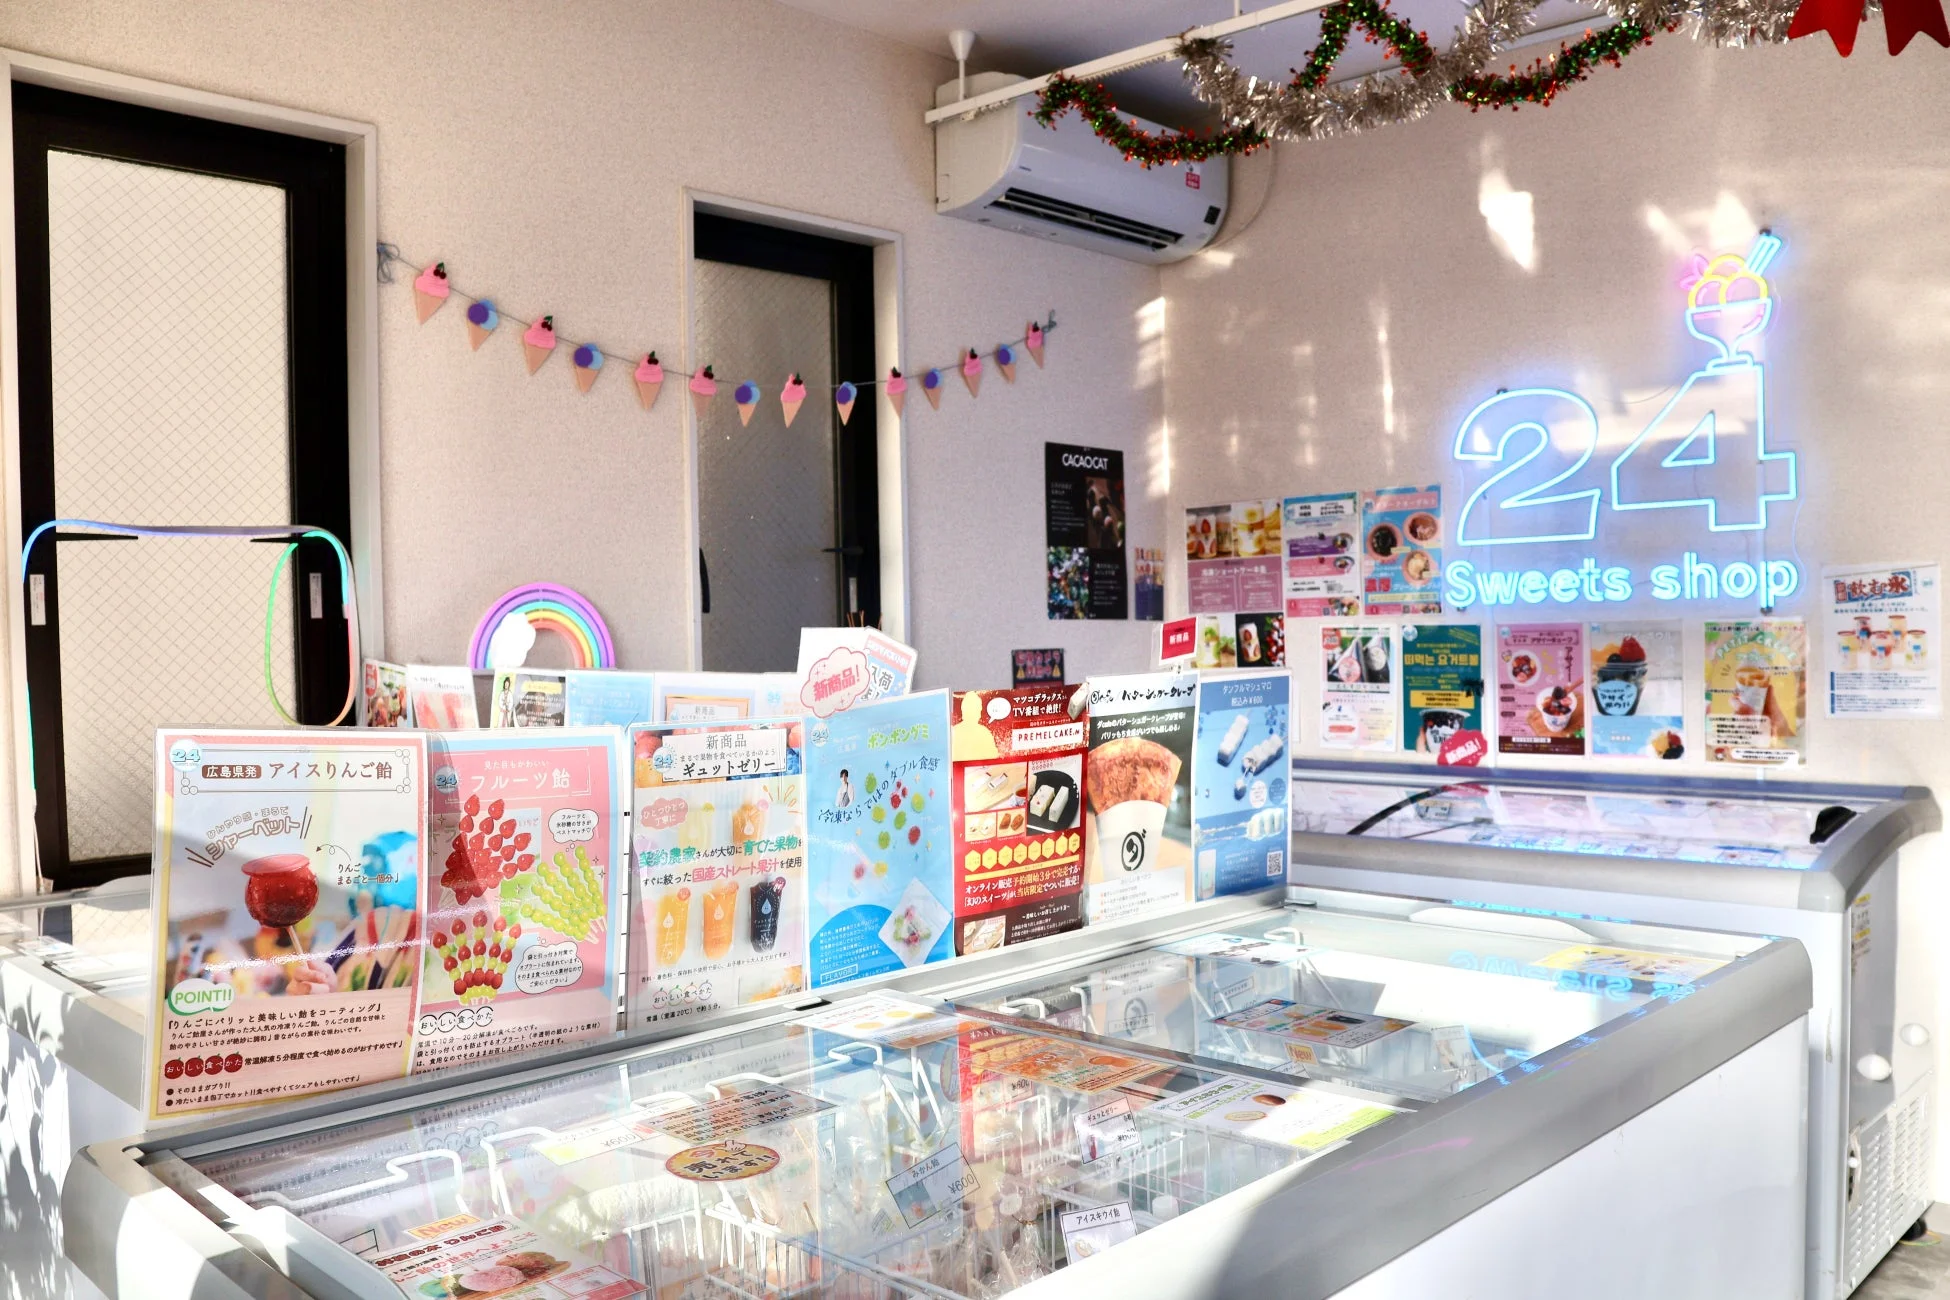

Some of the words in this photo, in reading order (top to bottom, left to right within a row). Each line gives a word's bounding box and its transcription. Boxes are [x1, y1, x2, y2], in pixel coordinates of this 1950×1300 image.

[1062, 453, 1109, 470] CACAOCAT
[1453, 362, 1797, 547] 24
[1445, 558, 1632, 608] Sweets
[1652, 551, 1799, 608] shop
[813, 664, 860, 702] 新商品!
[705, 733, 747, 750] 新商品
[1018, 731, 1052, 742] PREMEL
[171, 749, 200, 763] 24
[206, 765, 257, 778] 広島県発
[269, 761, 393, 780] アイスりんご飴
[682, 758, 776, 778] ギュットゼリー
[435, 774, 458, 787] 24
[470, 767, 570, 793] フルーツ飴
[643, 802, 685, 820] ひとつひとつ
[654, 815, 676, 827] 丁寧に
[205, 816, 301, 861] シャーベット
[337, 863, 362, 873] りんご
[175, 989, 233, 1005] POINT!!
[421, 1011, 492, 1030] おいしい食べかた
[166, 1059, 243, 1074] おいしい食べかた
[911, 1158, 940, 1179] みかん飴
[947, 1173, 975, 1195] ¥600
[1076, 1207, 1121, 1225] アイスキウイ飴
[417, 1216, 469, 1237] New
